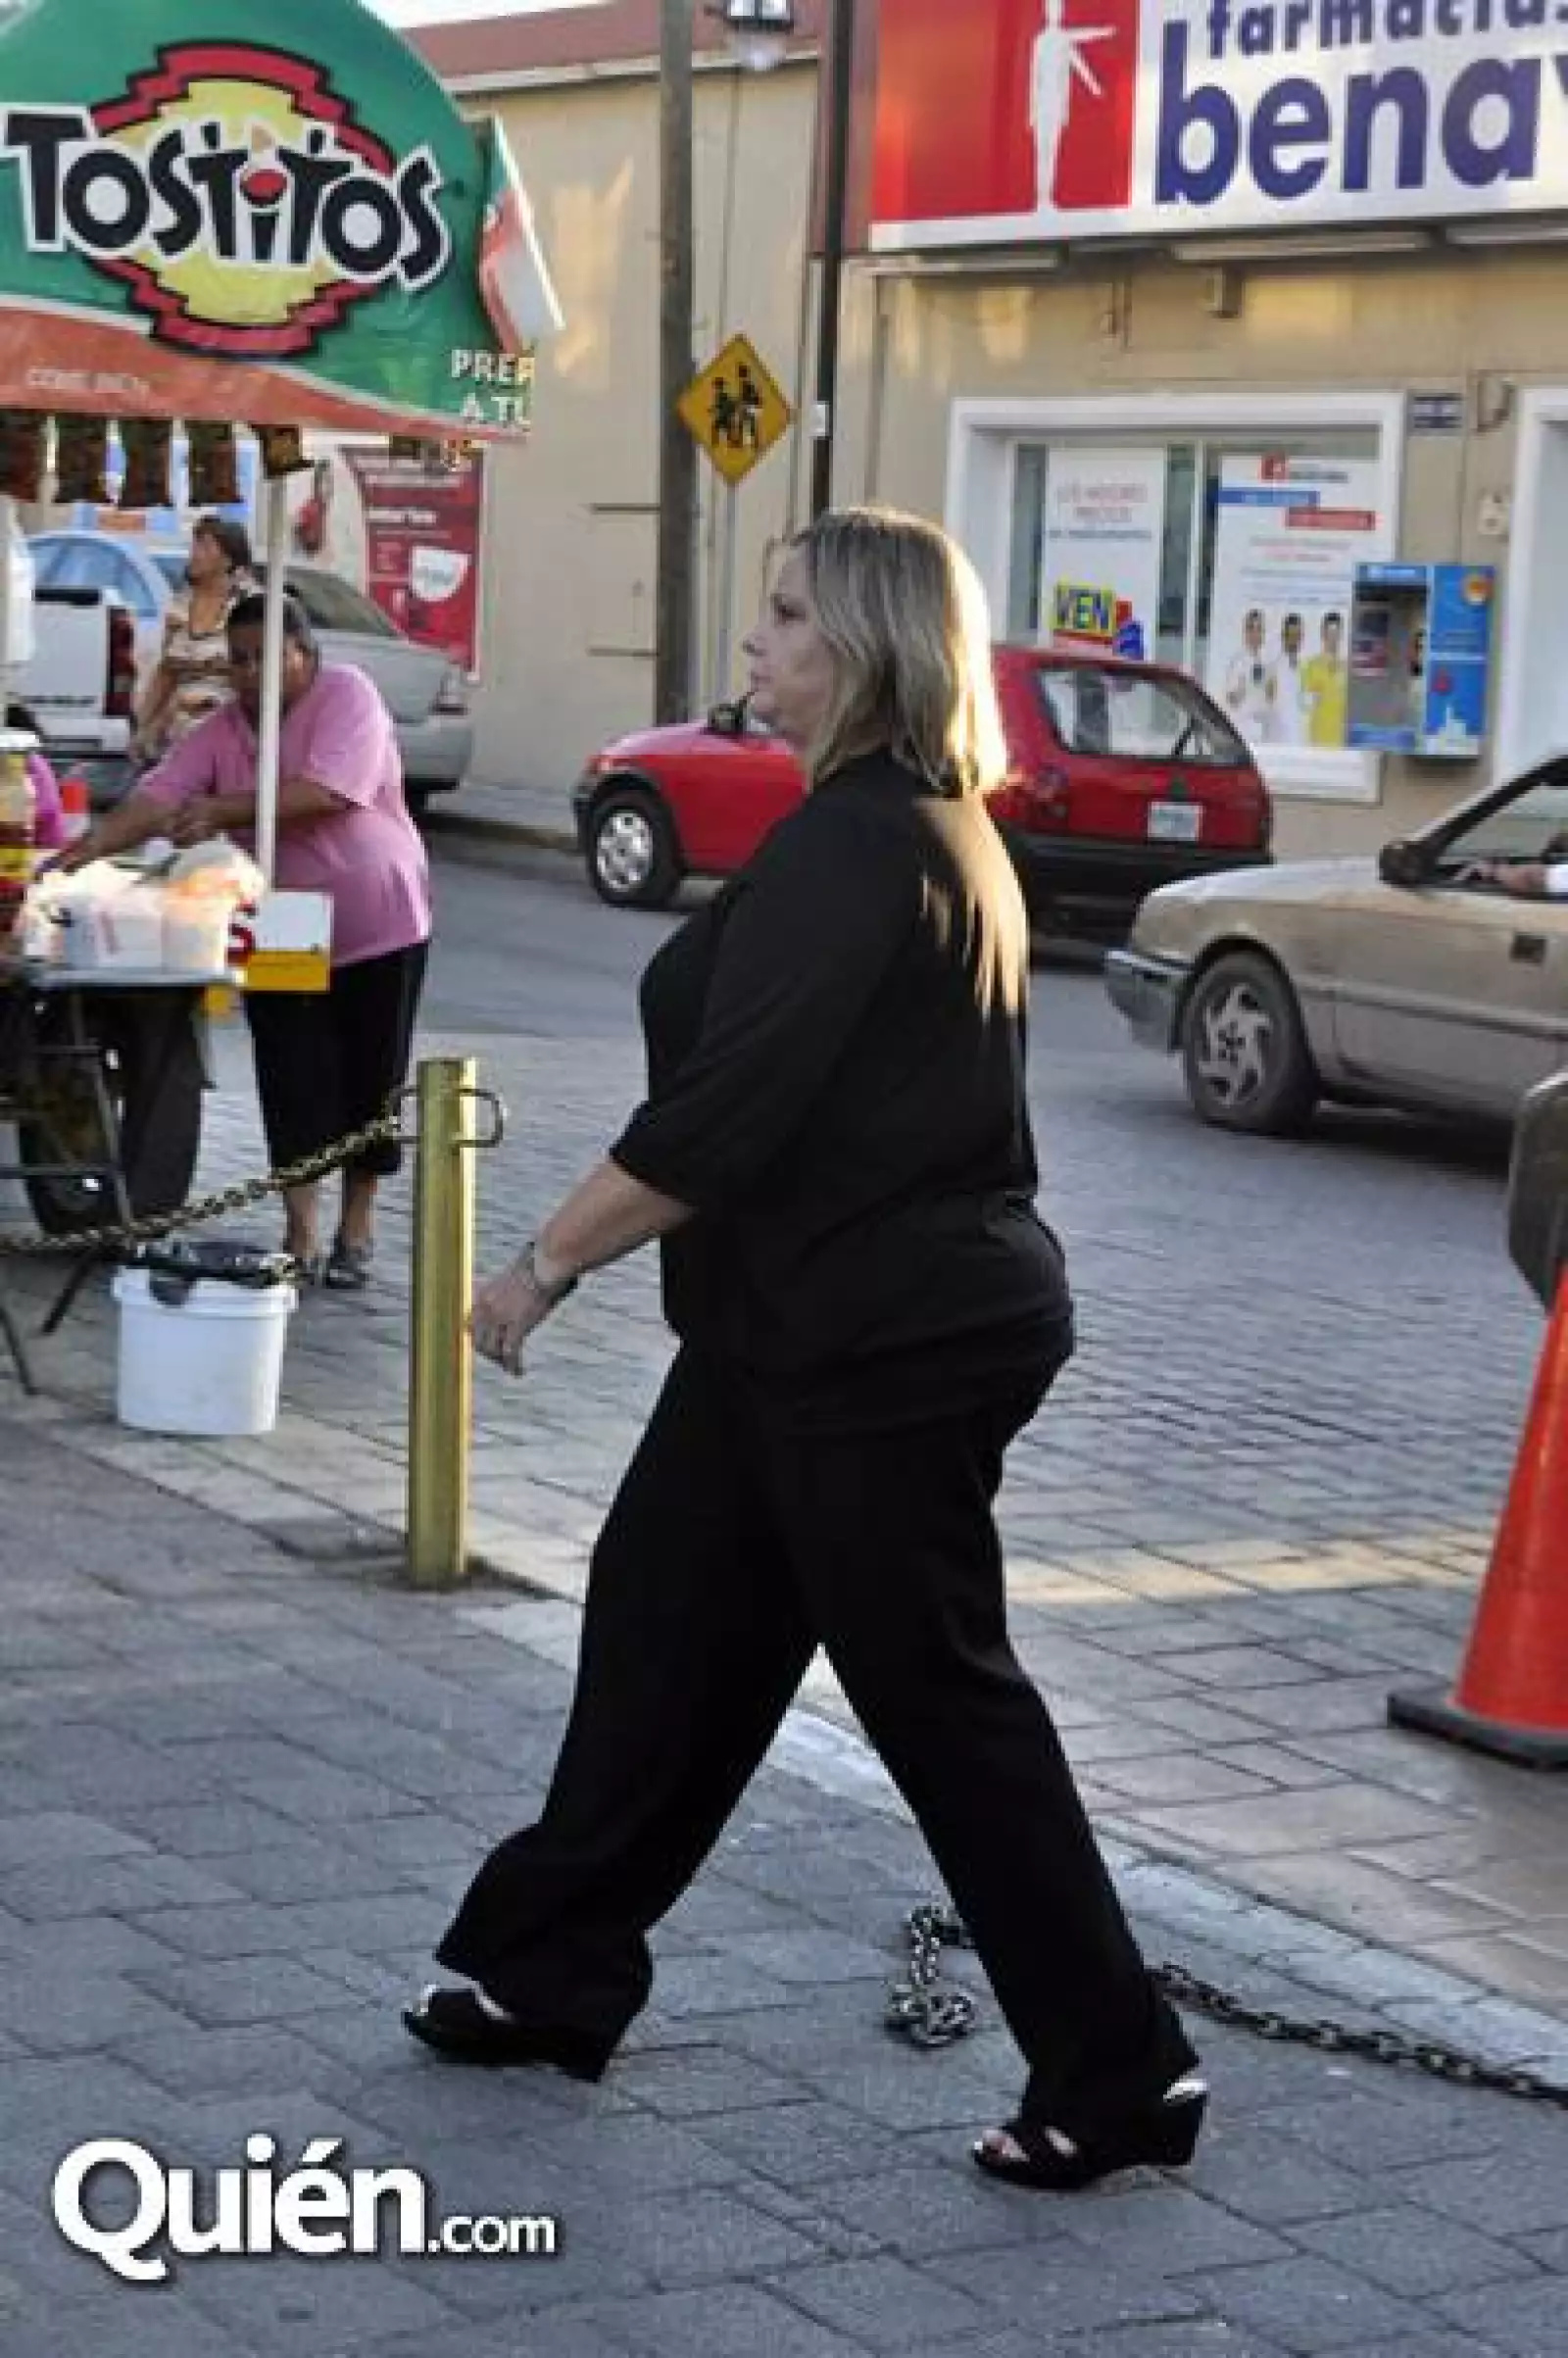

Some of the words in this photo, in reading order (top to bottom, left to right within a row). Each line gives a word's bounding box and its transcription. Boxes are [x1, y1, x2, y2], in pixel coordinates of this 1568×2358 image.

[1206, 0, 1568, 58] farmacia
[1154, 21, 1568, 206] bena
[460, 392, 484, 419] A
